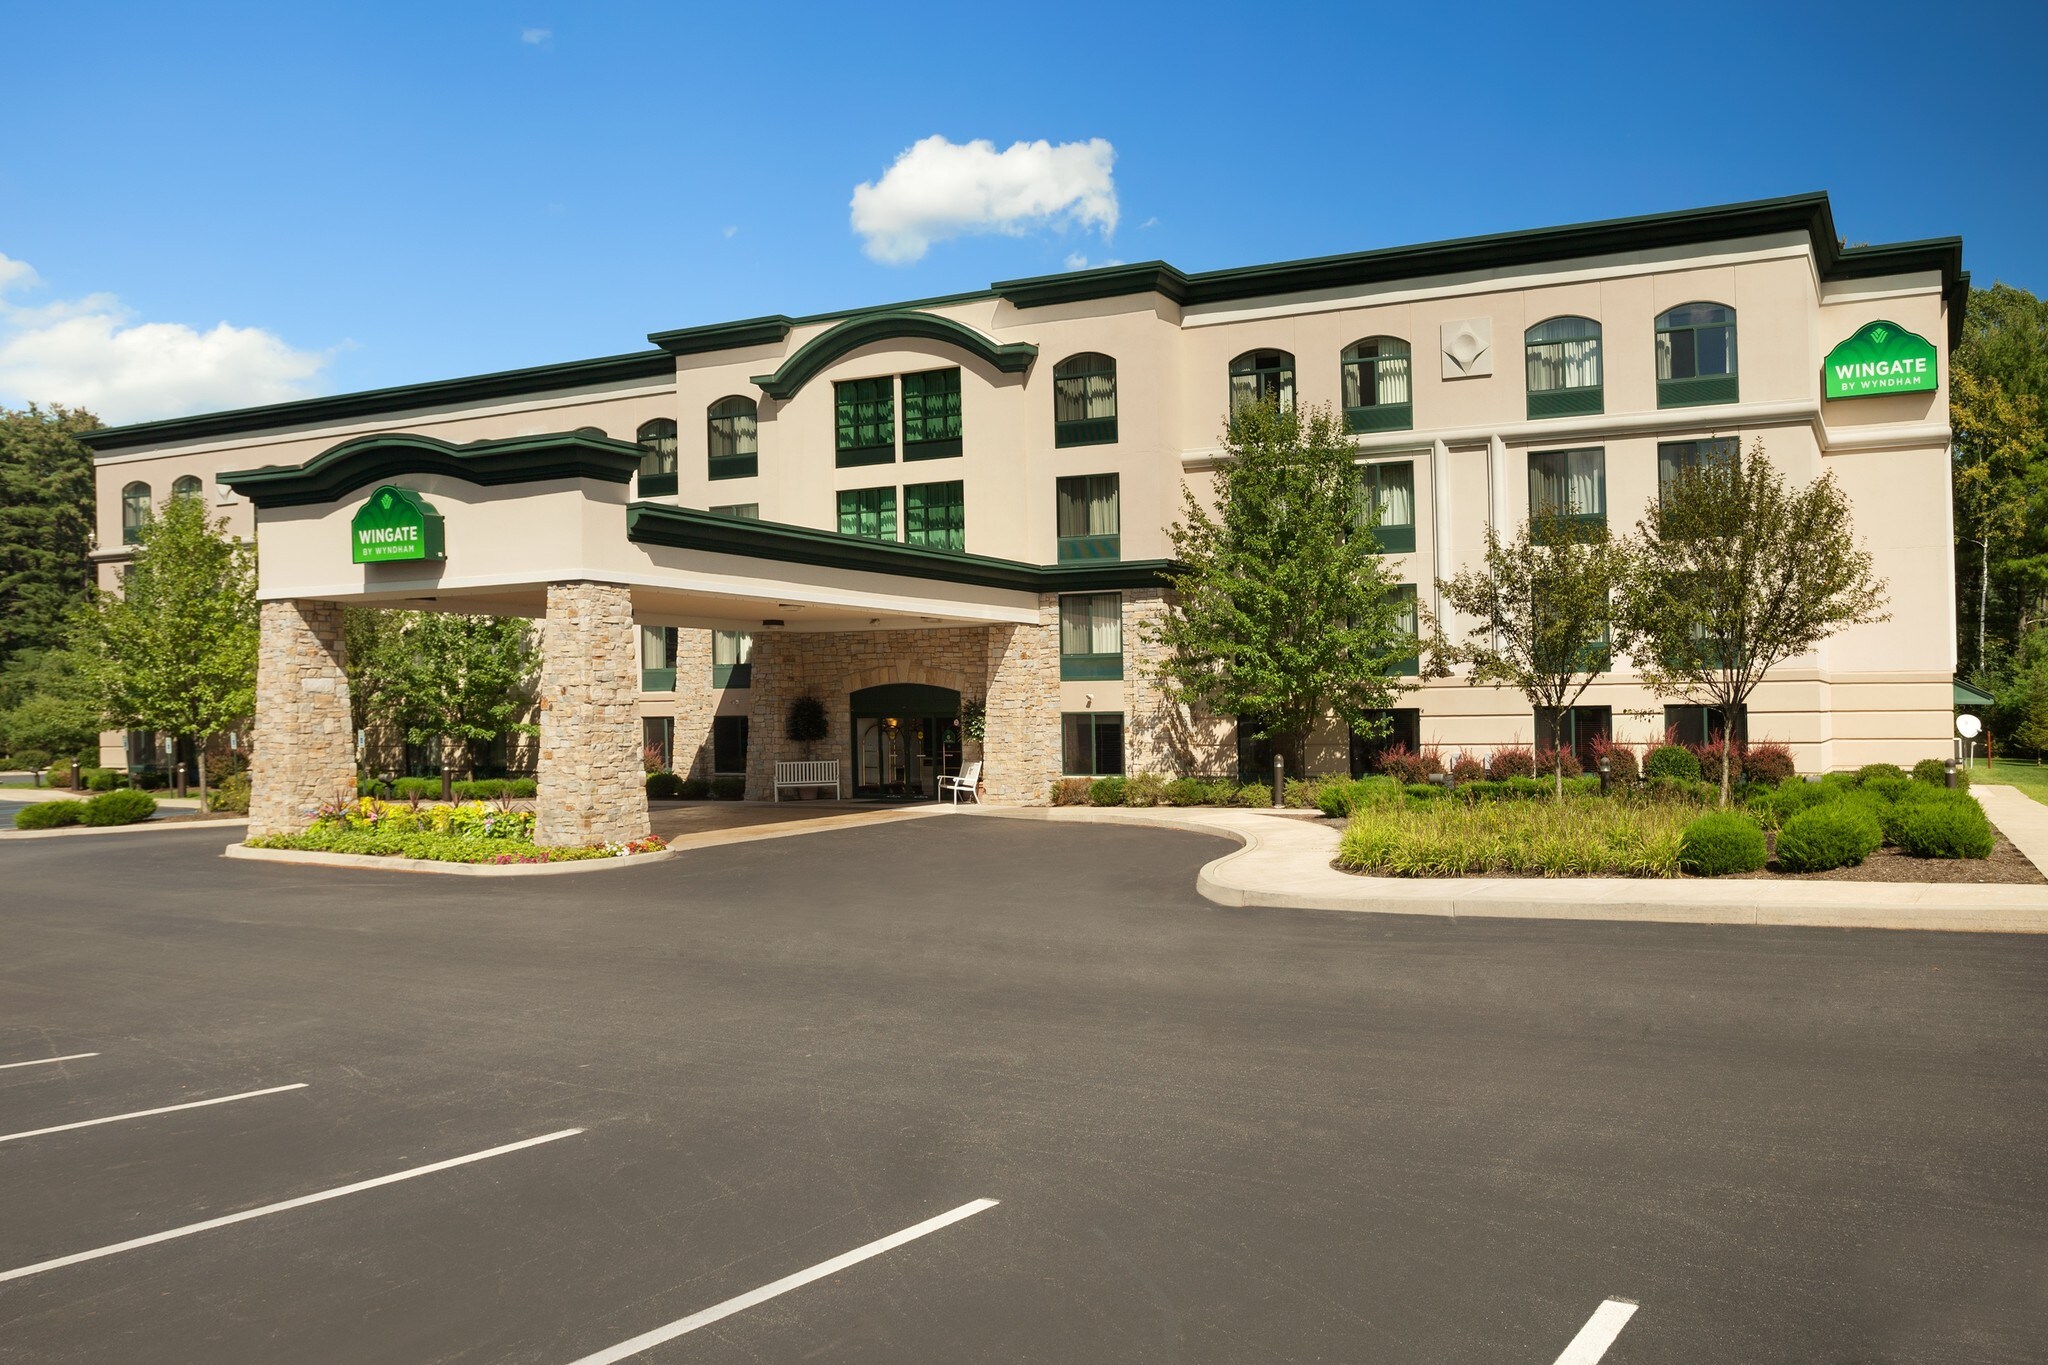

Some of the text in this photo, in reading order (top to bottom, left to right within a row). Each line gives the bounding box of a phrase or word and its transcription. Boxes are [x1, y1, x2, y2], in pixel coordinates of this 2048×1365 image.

[1835, 357, 1927, 380] WINGATE
[1841, 376, 1921, 391] BY WYNDHAM
[358, 526, 418, 544] WINGATE
[362, 545, 415, 556] BY WYNDHAM
